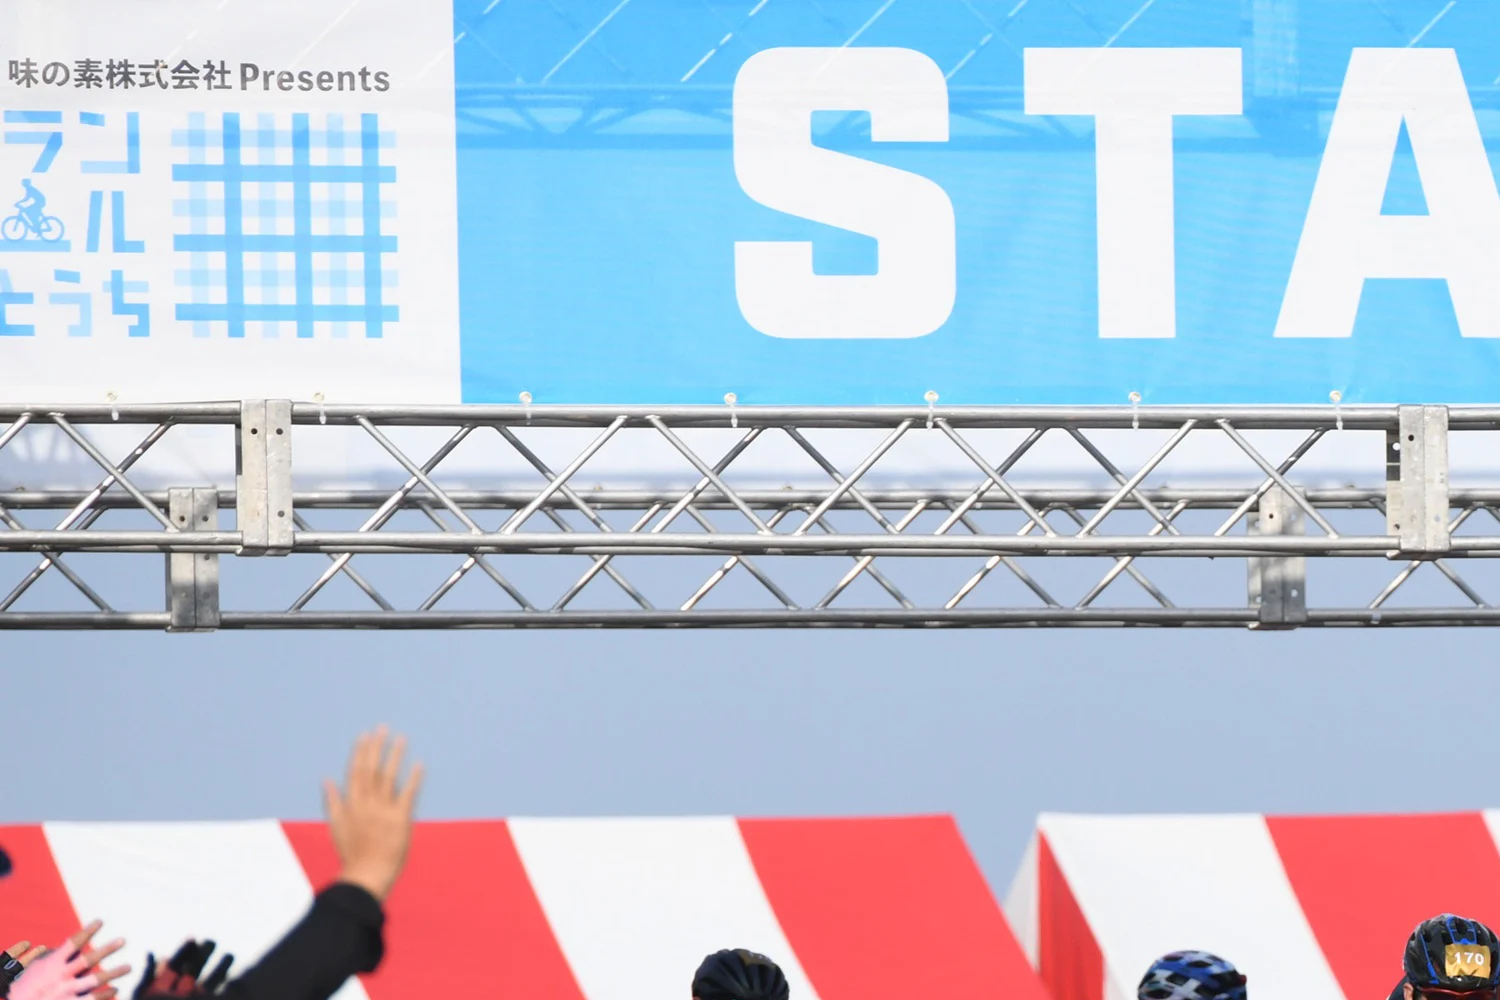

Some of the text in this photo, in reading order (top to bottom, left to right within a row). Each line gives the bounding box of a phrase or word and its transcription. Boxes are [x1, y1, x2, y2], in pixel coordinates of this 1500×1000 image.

[8, 58, 391, 92] 味の素株式会社 Presents
[1454, 951, 1485, 966] 170
